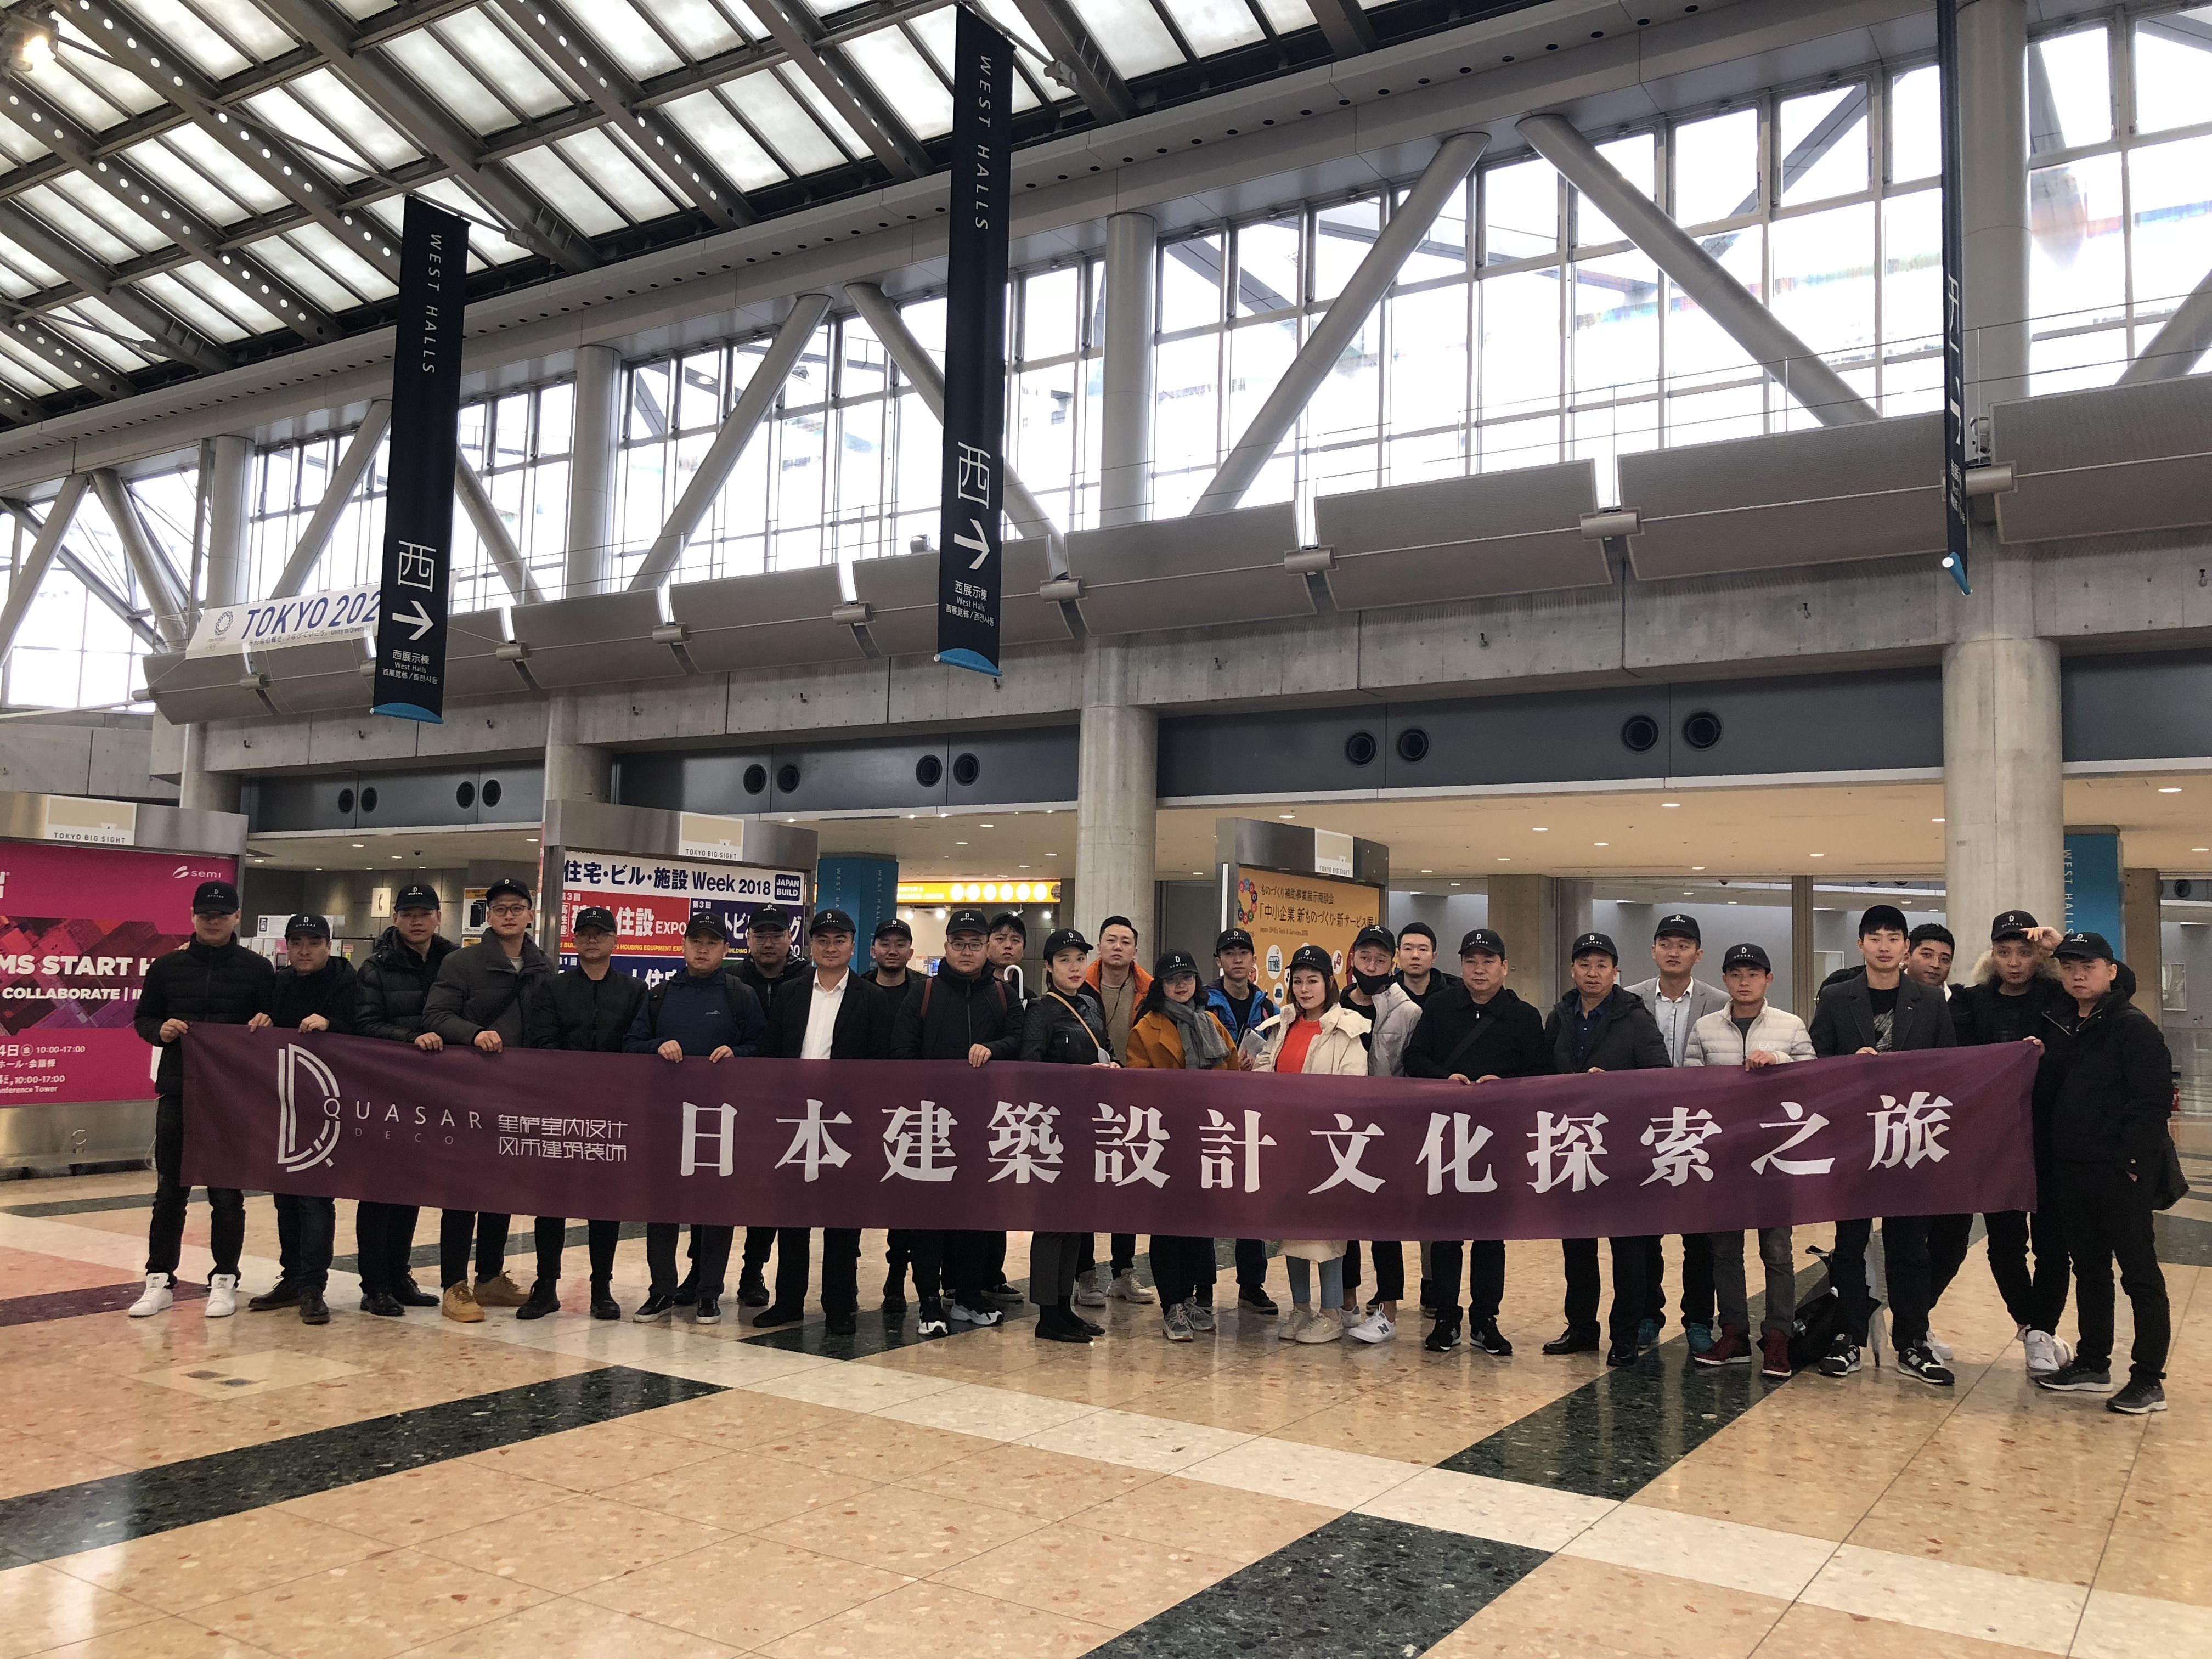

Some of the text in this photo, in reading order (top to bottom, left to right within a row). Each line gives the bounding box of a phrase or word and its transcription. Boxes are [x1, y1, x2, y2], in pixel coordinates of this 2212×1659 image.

[975, 55, 992, 230] WEST HALLS
[422, 234, 442, 373] WEST HALLS
[958, 441, 991, 510] 西
[398, 540, 437, 592] 西
[955, 579, 988, 602] 西展示棟
[956, 595, 985, 612] West Halls
[241, 590, 381, 640] TOKYO 202
[393, 649, 430, 665] 西展示棟
[394, 661, 427, 673] West Halls
[54, 832, 81, 840] TOKYO
[686, 848, 706, 856] TOKYO
[191, 870, 222, 879] semi
[564, 859, 771, 896] 住宅・ビル・施設 Week 2018
[776, 878, 799, 887] JAPAN
[776, 888, 798, 897] BUILD
[655, 921, 687, 935] EXPO
[41, 955, 133, 976] START
[2, 987, 121, 1000] COLLABORATE
[36, 1045, 86, 1054] 10:00-17:00
[323, 1097, 483, 1130] QUASAR
[355, 1127, 454, 1146] DECO
[680, 1090, 1954, 1196] 日本建築設計文化探索之旅
